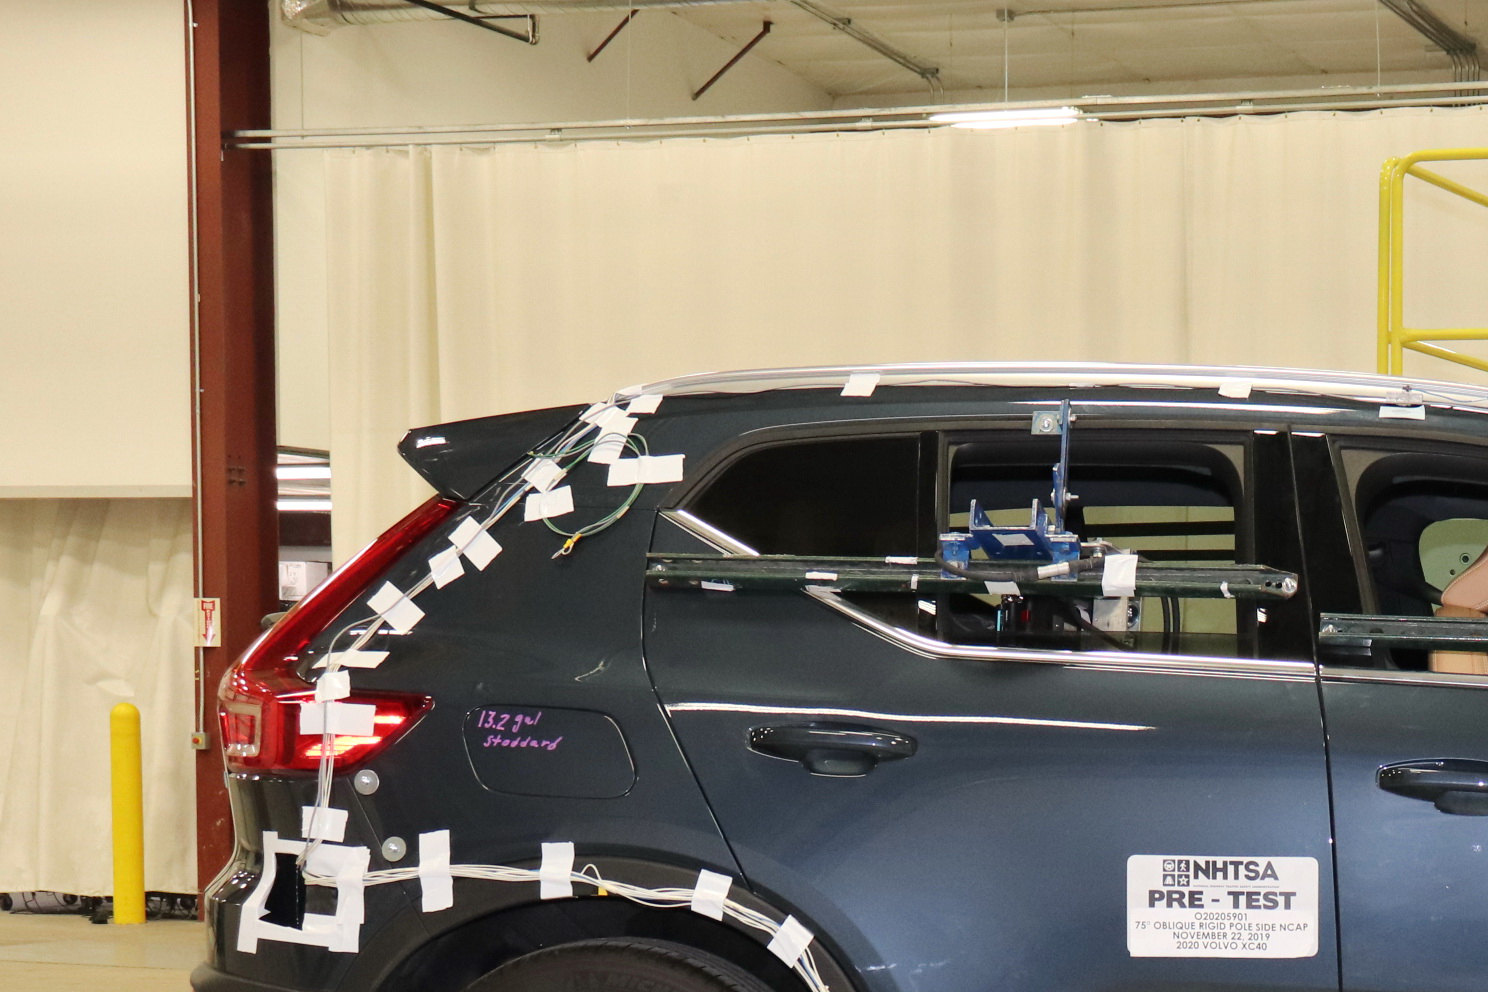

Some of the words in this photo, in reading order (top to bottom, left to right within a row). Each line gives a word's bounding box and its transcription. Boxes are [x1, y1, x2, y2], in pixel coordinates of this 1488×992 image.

[478, 710, 510, 731] 13.2
[1193, 860, 1280, 881] NHTSA
[1148, 889, 1205, 909] PRE
[1227, 891, 1297, 910] TEST
[1153, 921, 1196, 930] OBLIQUE
[1199, 921, 1227, 931] RIGID
[1229, 922, 1253, 931] POLE
[1255, 923, 1277, 932] SIDE
[1279, 923, 1309, 932] NCAP
[1172, 931, 1228, 940] NOVEMBER
[1230, 932, 1245, 941] 22,
[1248, 932, 1271, 941] 2019
[1176, 941, 1200, 950] 2020
[1202, 941, 1238, 950] VOLVO
[1241, 942, 1268, 951] XC40
